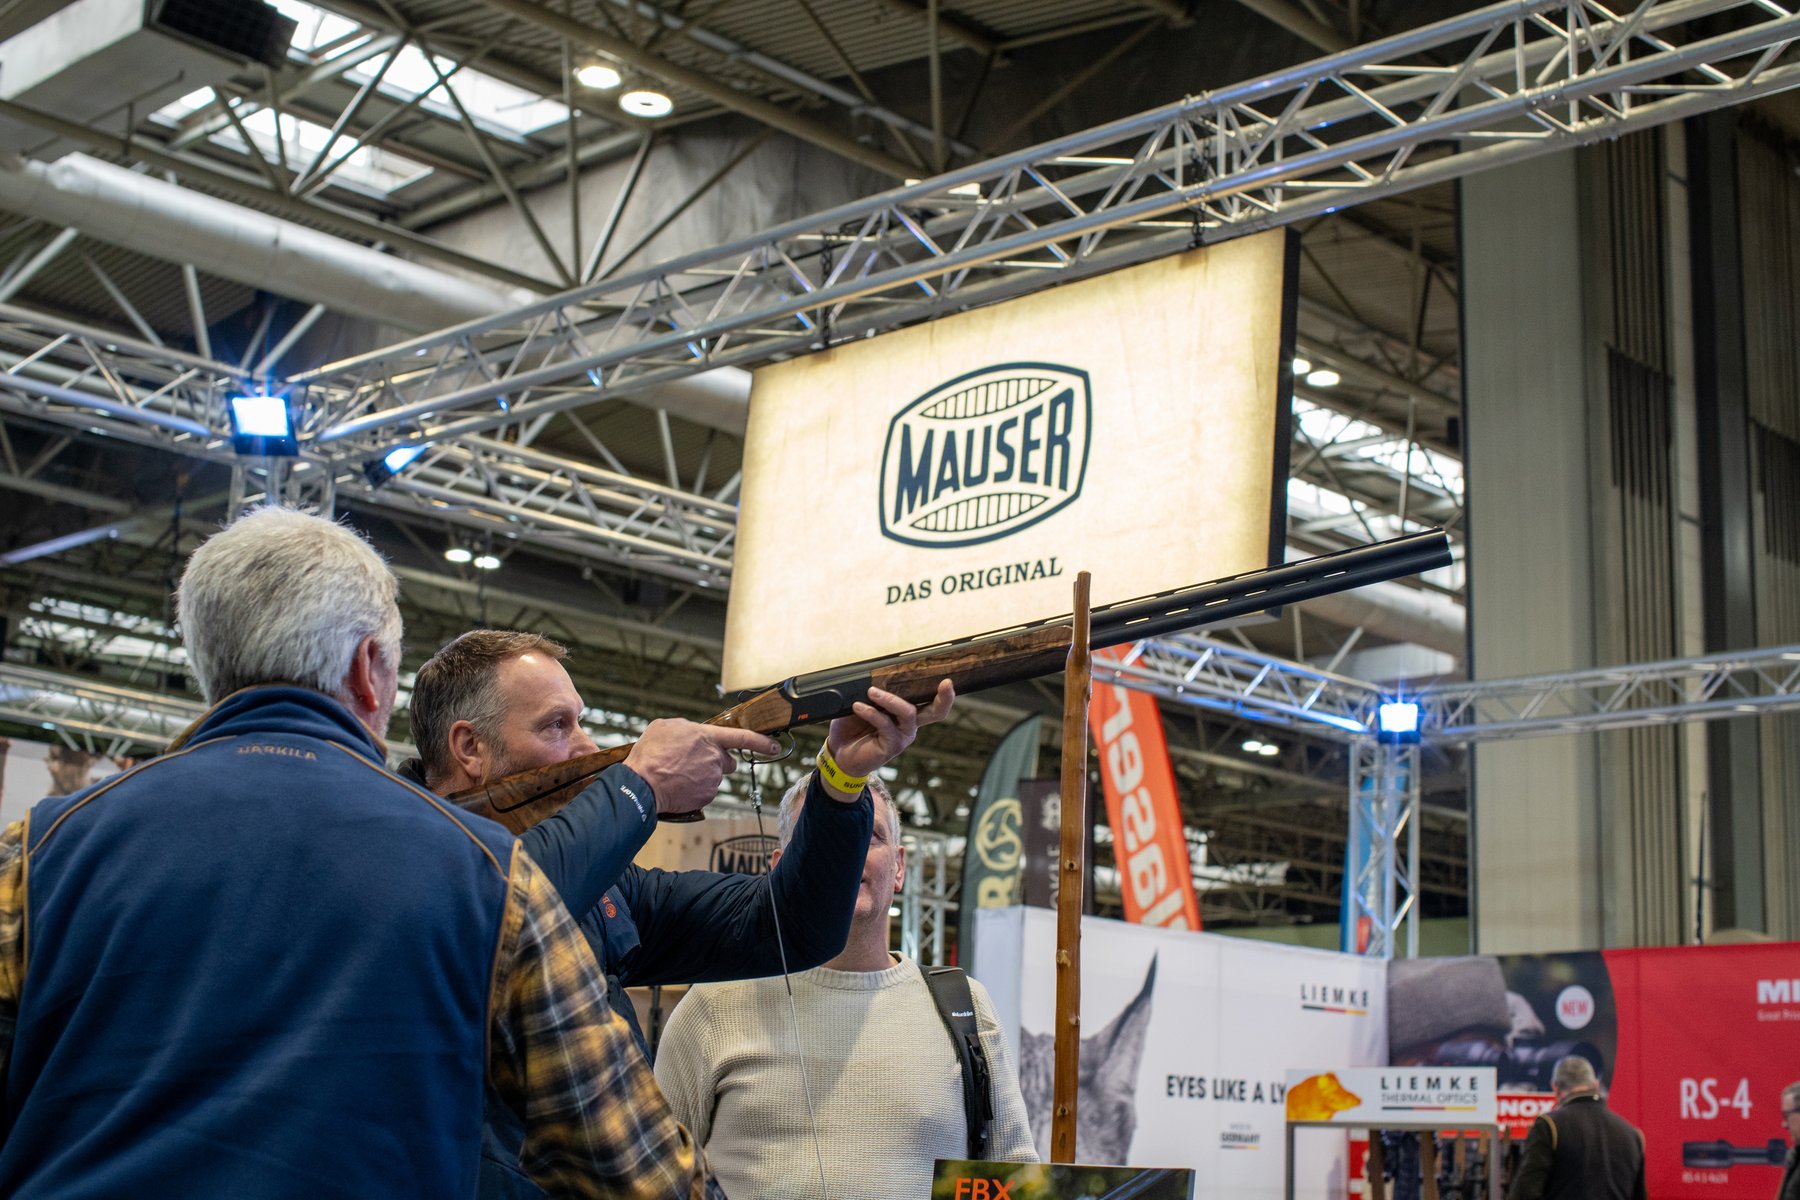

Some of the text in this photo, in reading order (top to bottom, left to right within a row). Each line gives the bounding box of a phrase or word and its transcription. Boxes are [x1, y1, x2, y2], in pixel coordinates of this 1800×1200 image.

[894, 387, 1074, 525] MAUSER
[885, 557, 1063, 605] DAS ORIGINAL
[1301, 984, 1369, 1007] LIEMKE
[1561, 1000, 1588, 1016] NEW
[1166, 1075, 1206, 1099] EYES
[1213, 1078, 1246, 1102] LIKE
[1253, 1080, 1264, 1103] A
[1381, 1077, 1478, 1090] LIEMKE
[1381, 1093, 1478, 1104] THERMAL OPTICS
[1680, 1078, 1753, 1119] RS-4
